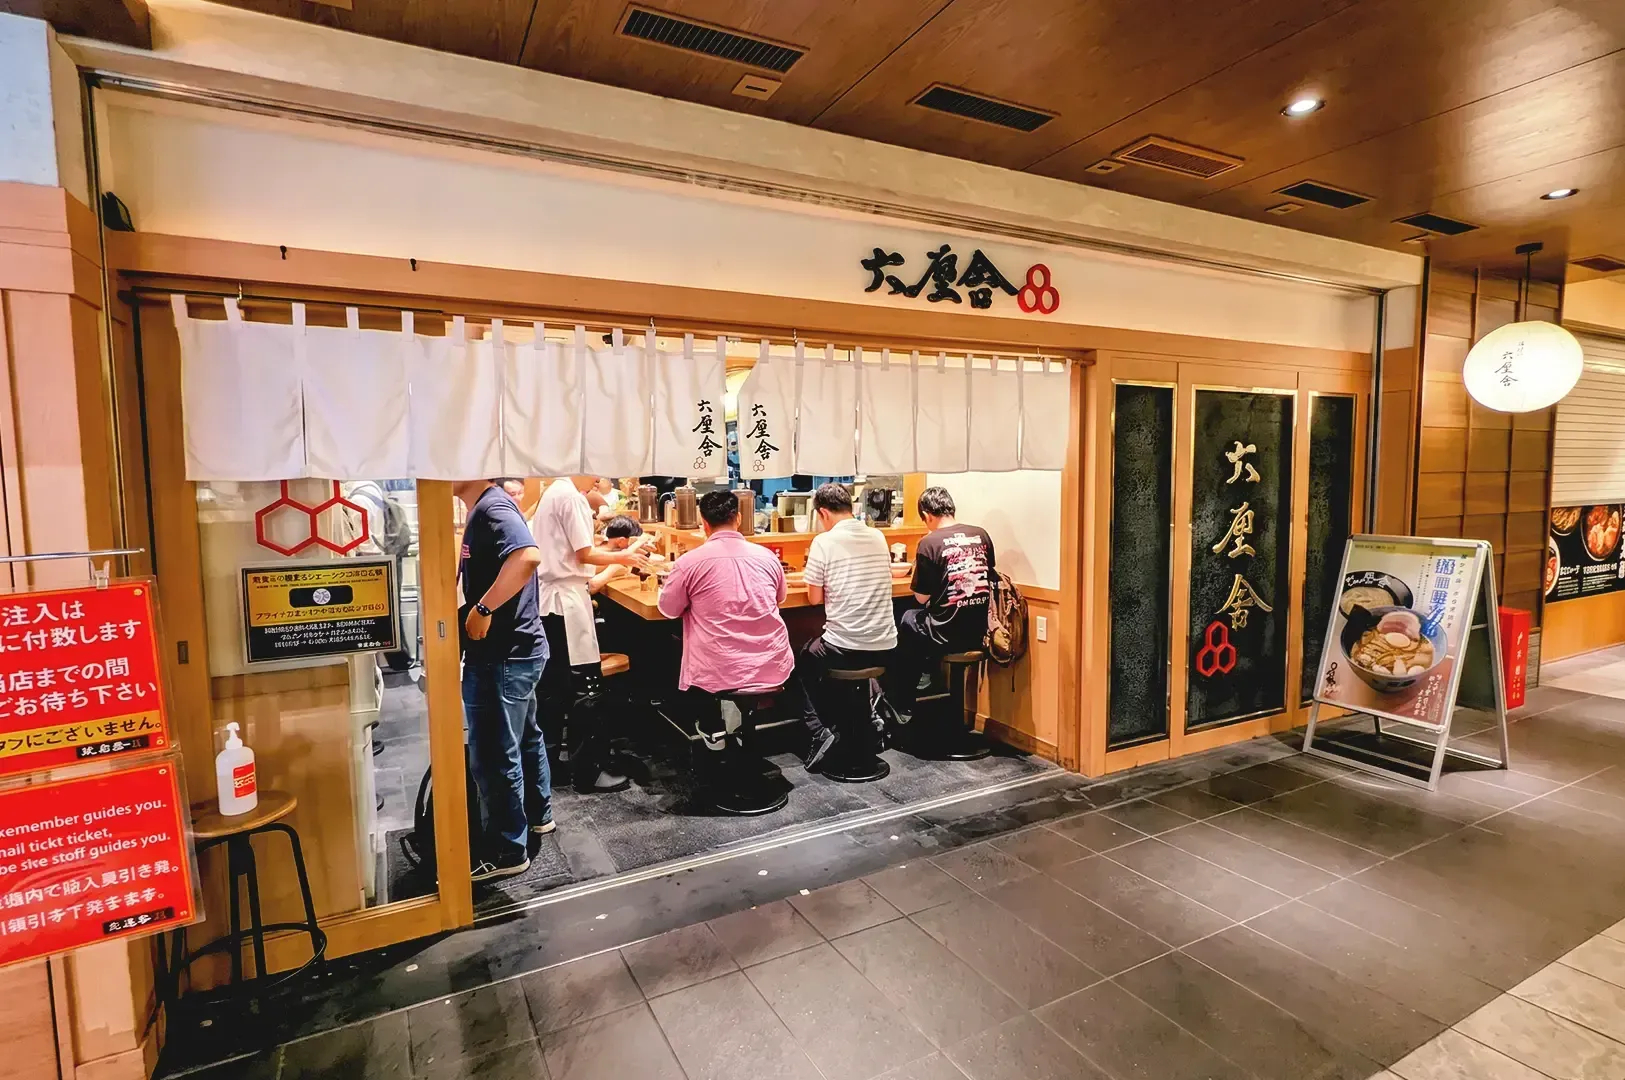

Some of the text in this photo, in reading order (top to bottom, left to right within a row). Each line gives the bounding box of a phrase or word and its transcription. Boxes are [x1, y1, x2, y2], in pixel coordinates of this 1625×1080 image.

[860, 244, 1019, 309] 六厘舎
[1494, 351, 1518, 387] 六厘舎
[692, 400, 723, 457] 六厘舎
[746, 404, 780, 460] 六厘舎
[1212, 440, 1273, 632] 六厘舎
[0, 717, 162, 750] フにございません。
[83, 804, 131, 825] guides
[135, 800, 167, 815] you.
[29, 837, 64, 852] tickt
[66, 827, 113, 845] ticket,
[90, 838, 137, 856] guides
[141, 832, 171, 848] you.
